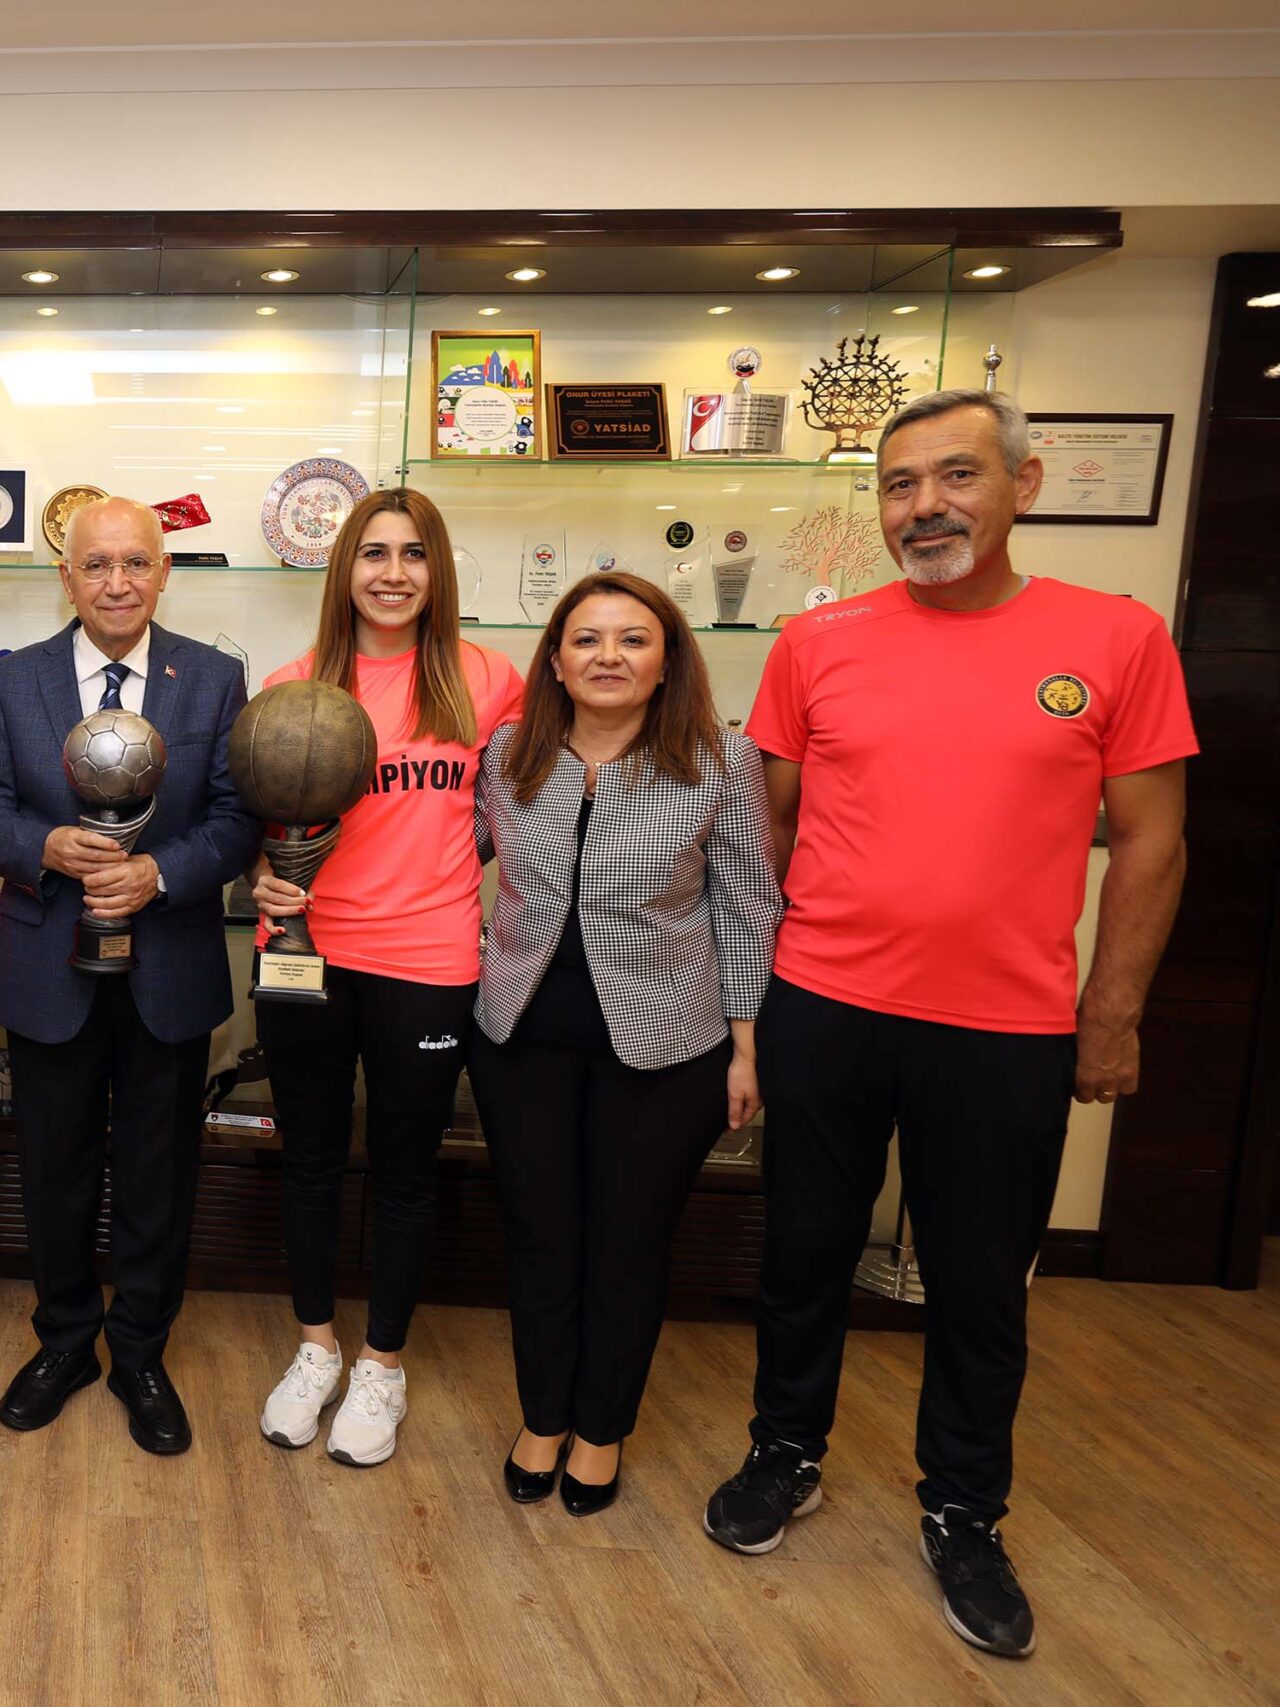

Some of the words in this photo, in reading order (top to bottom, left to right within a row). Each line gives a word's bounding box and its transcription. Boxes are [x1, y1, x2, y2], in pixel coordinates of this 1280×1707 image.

[566, 390, 590, 398] ONUR
[593, 421, 651, 433] YATSİAD
[814, 605, 873, 623] TRYON
